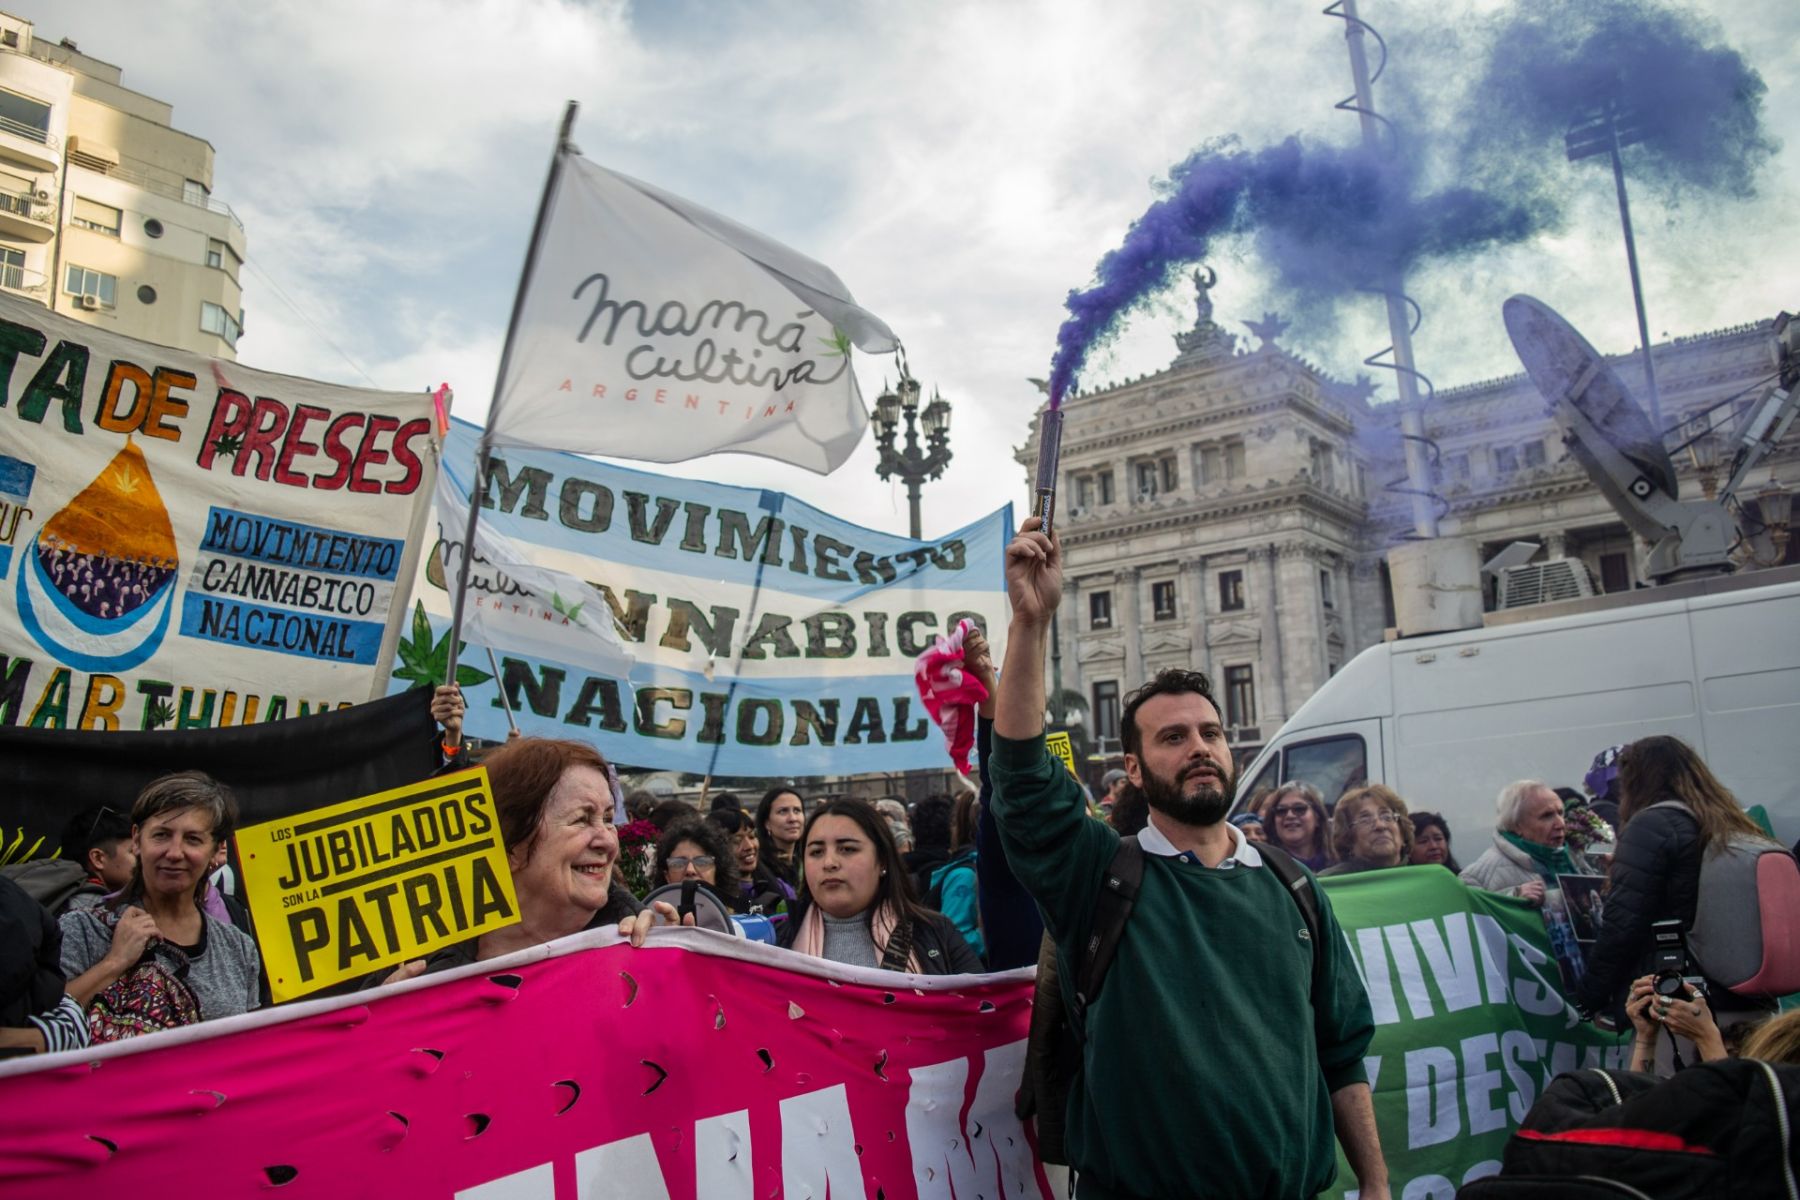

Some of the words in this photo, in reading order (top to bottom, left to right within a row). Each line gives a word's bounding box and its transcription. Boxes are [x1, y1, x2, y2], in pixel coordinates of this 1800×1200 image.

[94, 359, 197, 442] DE
[197, 387, 431, 496] PRESES
[559, 379, 795, 419] ARGENTINA
[207, 512, 397, 576] MOVIMIENTO
[469, 455, 966, 585] MOVIMIENTO
[202, 558, 375, 615] CANNABICO
[477, 597, 570, 626] ENTINA
[198, 600, 355, 658] NACIONAL
[491, 657, 928, 746] NACIONAL
[271, 827, 291, 842] LOS
[278, 792, 492, 890] JUBILADOS
[282, 894, 305, 909] SON
[307, 889, 320, 902] LA
[287, 856, 514, 983] PATRIA
